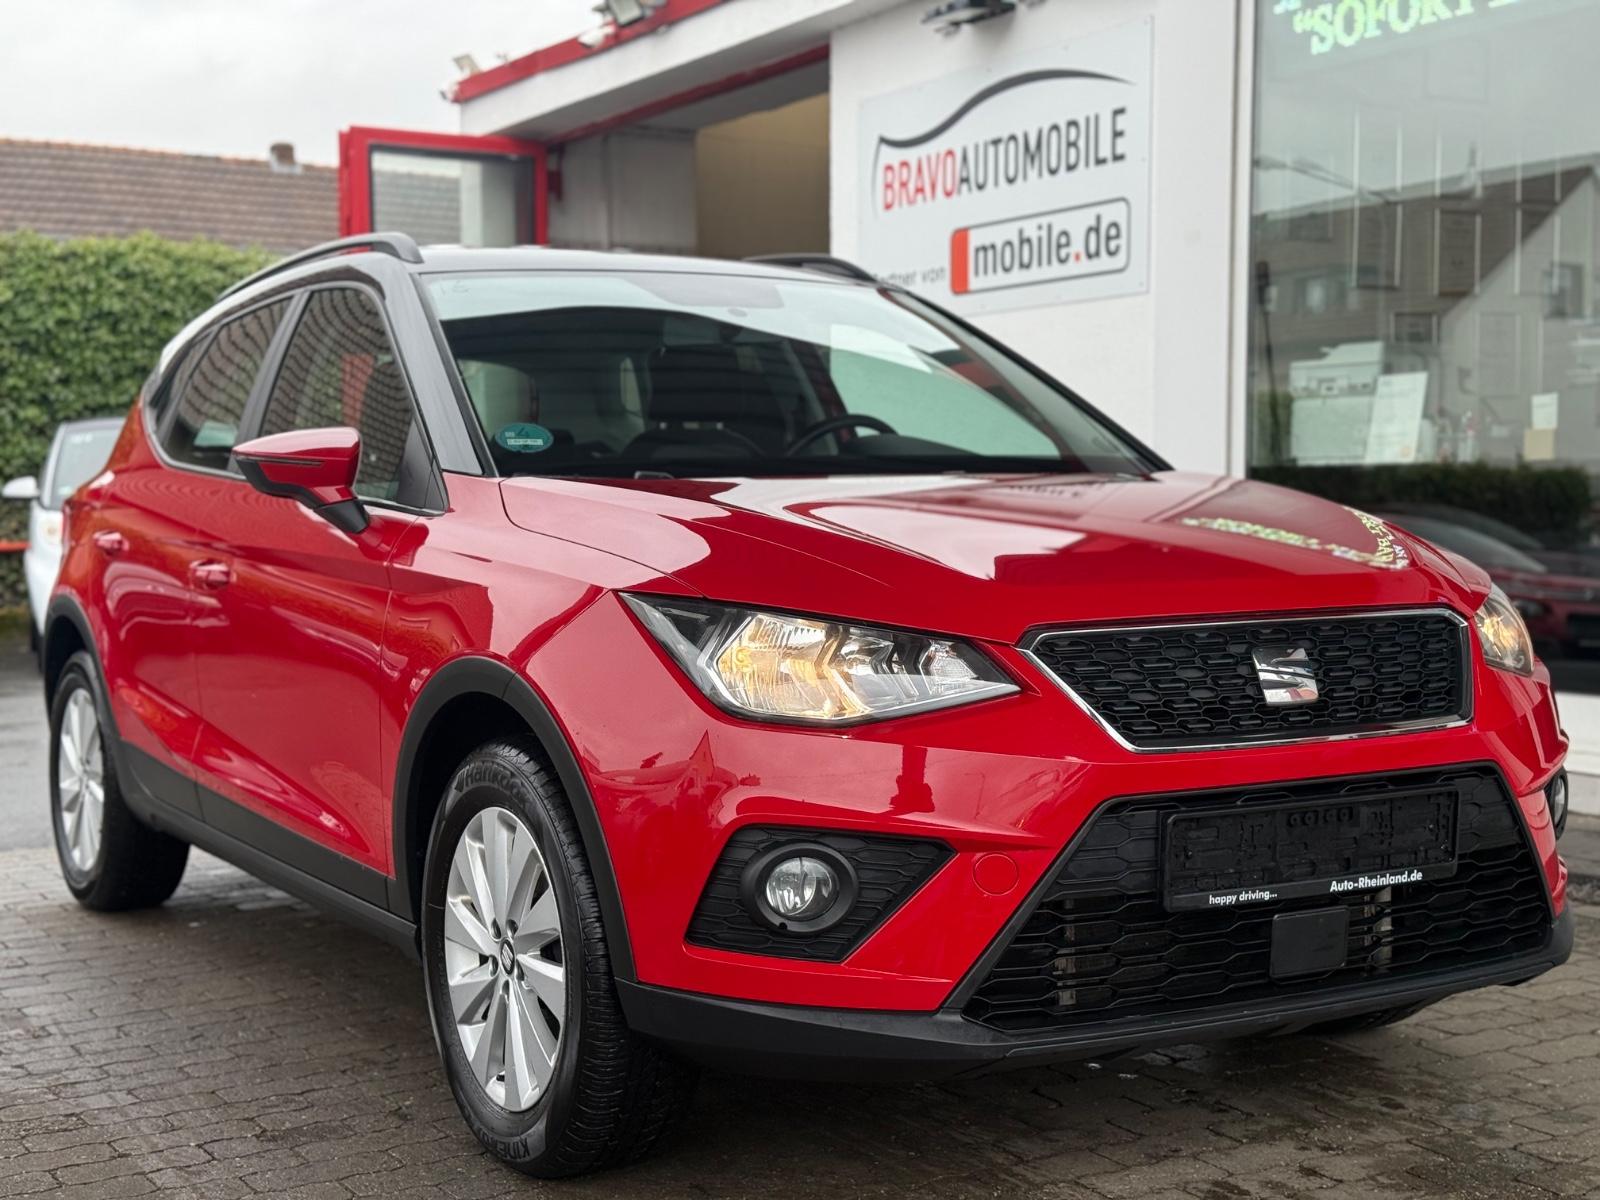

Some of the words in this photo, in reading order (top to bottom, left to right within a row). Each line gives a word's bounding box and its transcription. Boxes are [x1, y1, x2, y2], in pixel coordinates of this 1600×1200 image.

[883, 106, 1127, 211] BRAVOAUTOMOBILE
[973, 214, 1122, 278] mobile.de
[1208, 894, 1237, 905] happy
[1239, 889, 1278, 902] driving...
[1329, 869, 1423, 892] Auto-Rheinland.de
